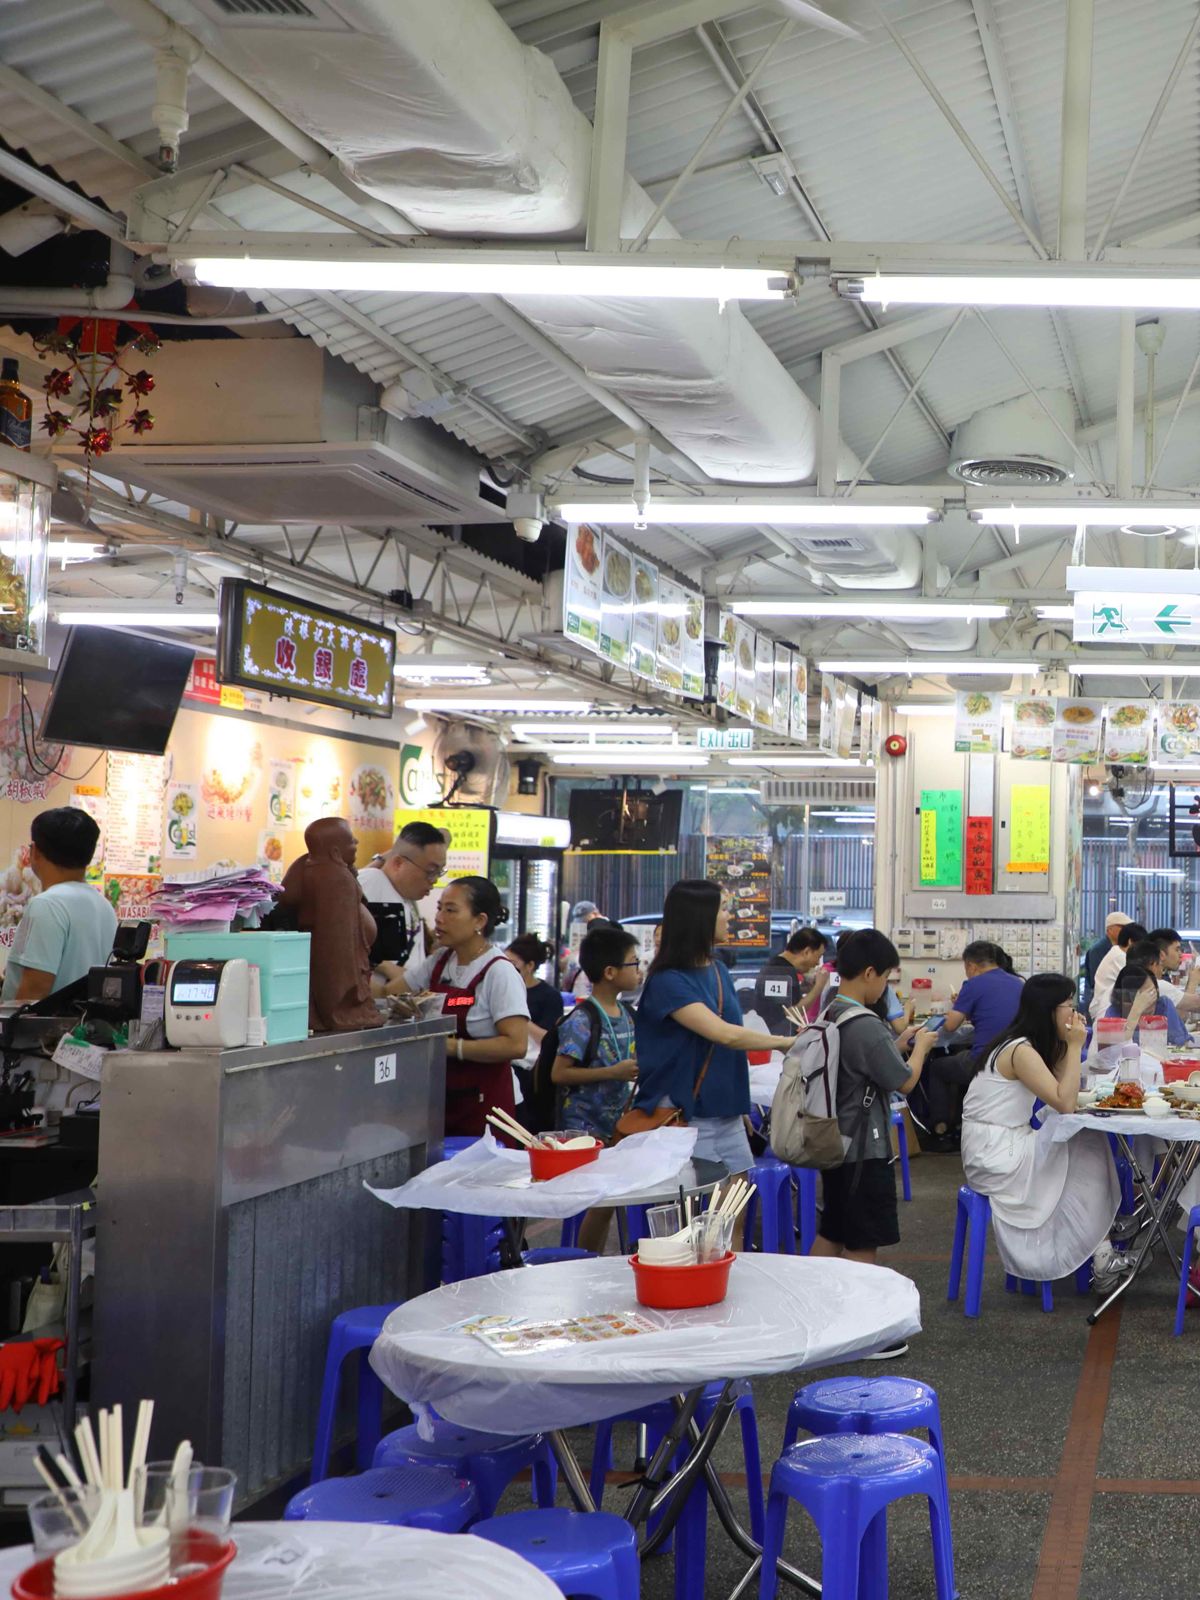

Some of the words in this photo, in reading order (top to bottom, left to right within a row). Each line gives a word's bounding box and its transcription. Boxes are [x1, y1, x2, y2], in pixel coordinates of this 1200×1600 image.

[275, 636, 368, 693] 收銀處
[700, 731, 723, 748] EXIT
[728, 731, 750, 748] 出口
[770, 984, 781, 993] 41
[379, 1057, 391, 1080] 36
